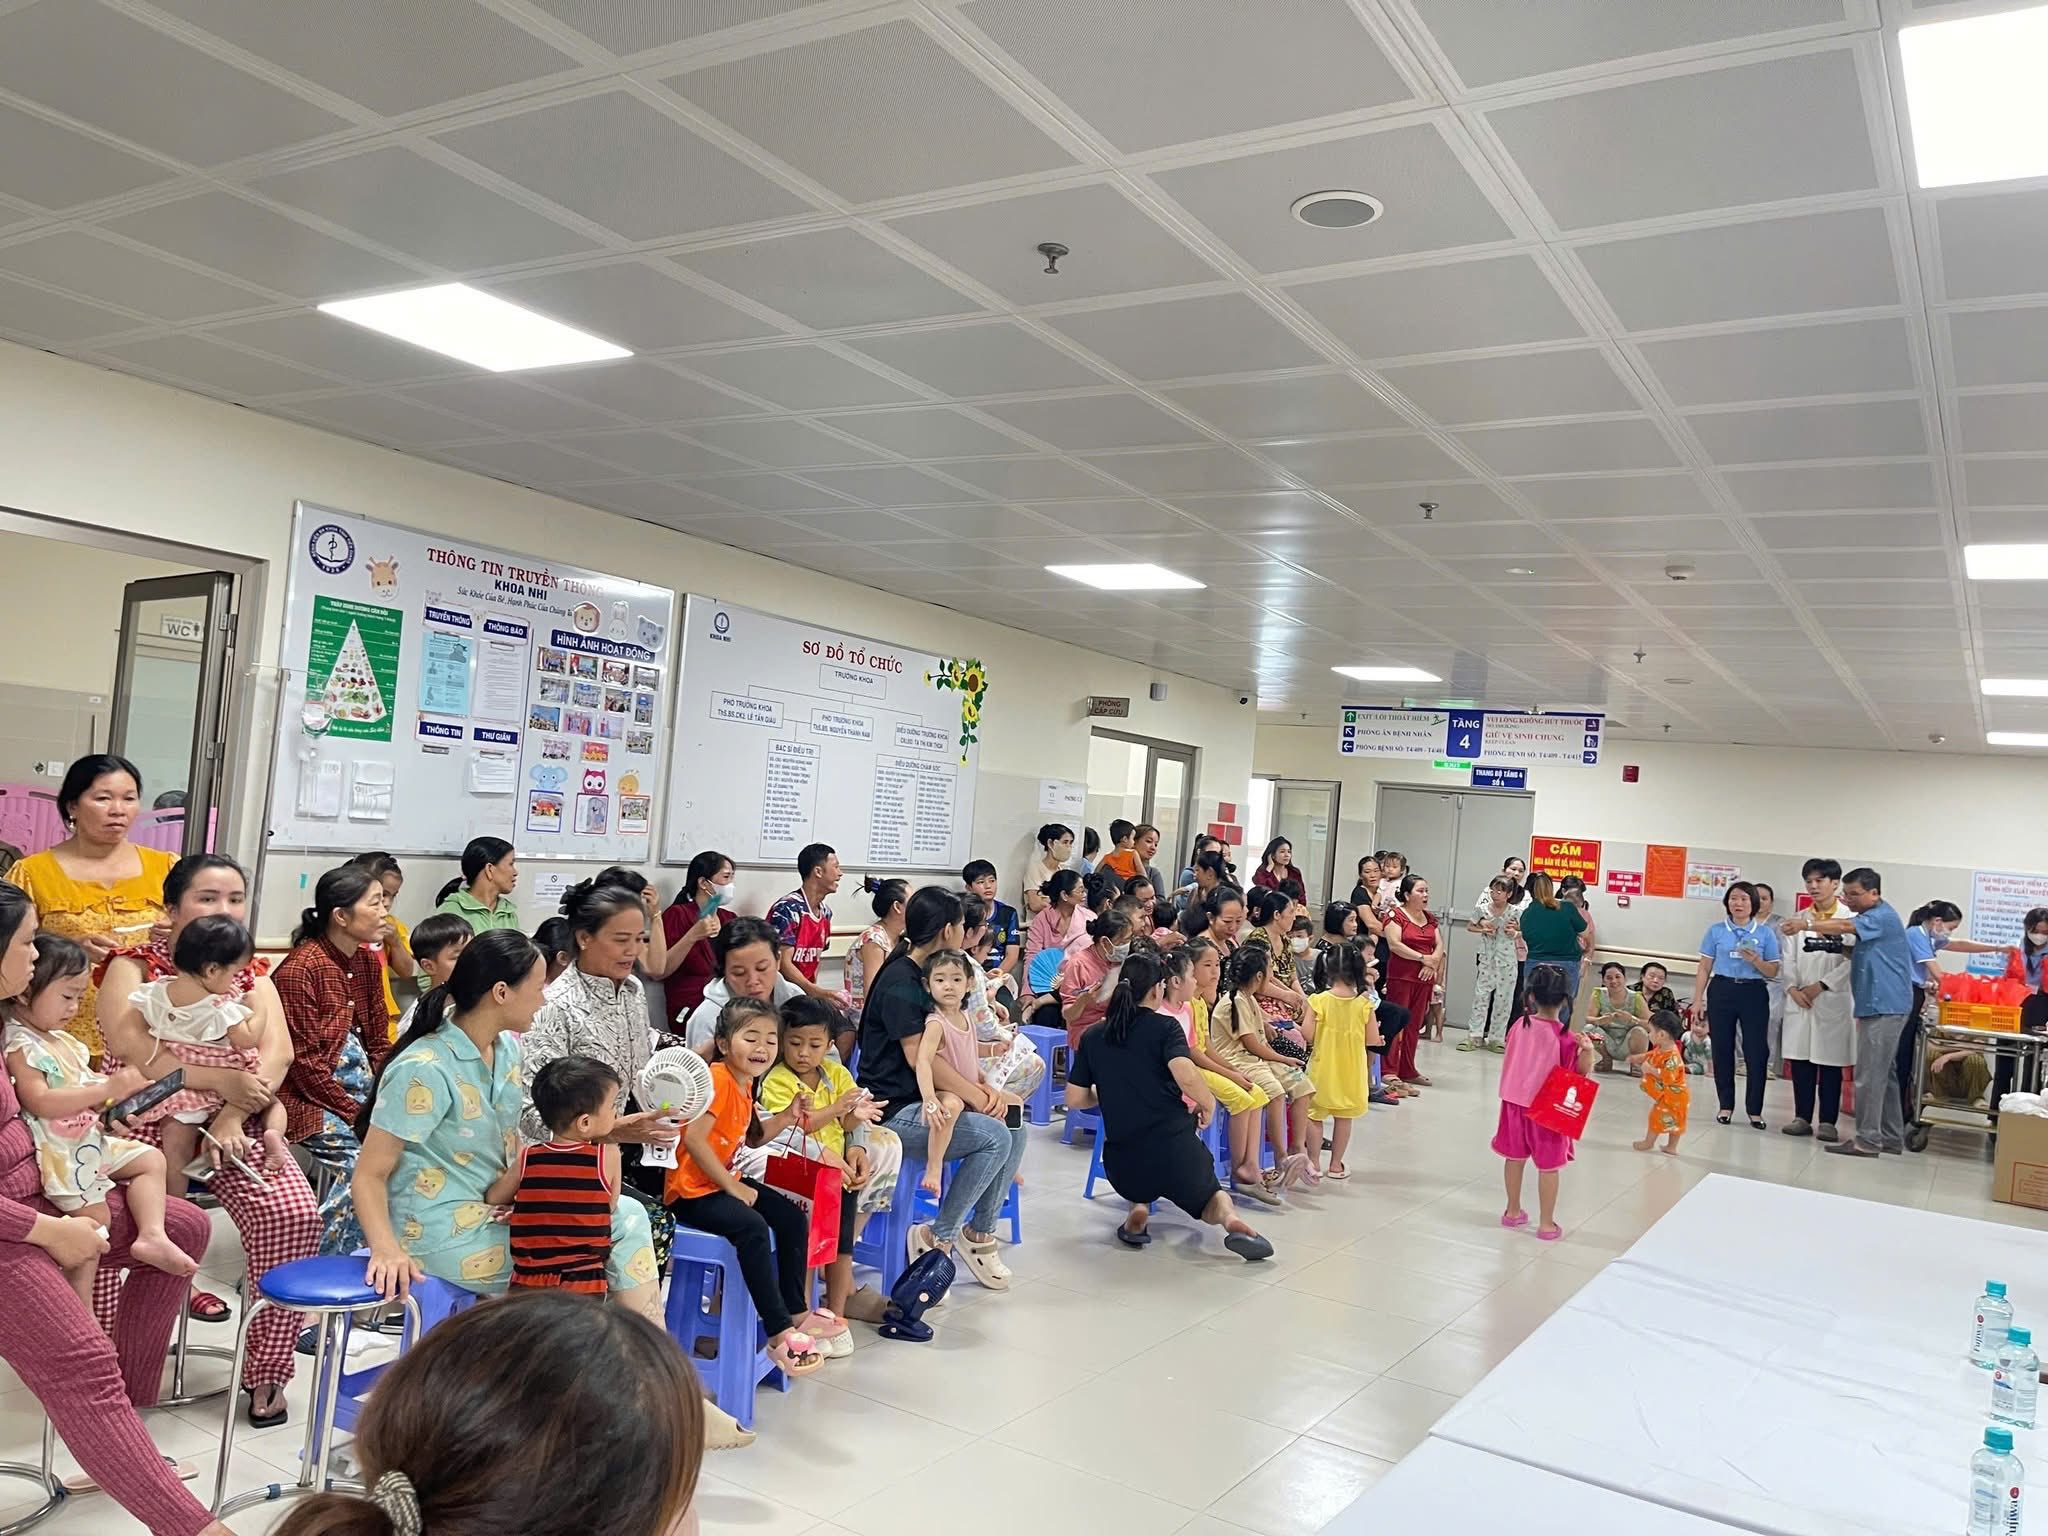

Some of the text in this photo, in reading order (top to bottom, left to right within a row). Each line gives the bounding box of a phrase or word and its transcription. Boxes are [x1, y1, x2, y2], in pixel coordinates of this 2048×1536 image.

[427, 548, 476, 571] THÔNG
[481, 560, 504, 577] TIN
[508, 568, 559, 589] TRUYỀN
[494, 579, 548, 601] KHOA NHI
[451, 615, 470, 626] THÔNG
[168, 624, 191, 637] WC
[488, 621, 524, 636] THÔNG BÁO
[556, 632, 651, 661] HÌNH ẢNH HOẠT ĐỘNG
[802, 640, 903, 674] SƠ ĐỒ TỔ CHỨC
[859, 674, 874, 684] KHOA
[758, 704, 772, 712] KHOA
[1452, 715, 1480, 729] TẦNG
[1519, 716, 1544, 725] KHÔNG
[426, 725, 462, 737] THÔNG TIN
[481, 731, 496, 740] THƯ
[1534, 733, 1565, 741] CHUNG
[1459, 734, 1470, 749] 4
[1550, 841, 1581, 856] CẤM
